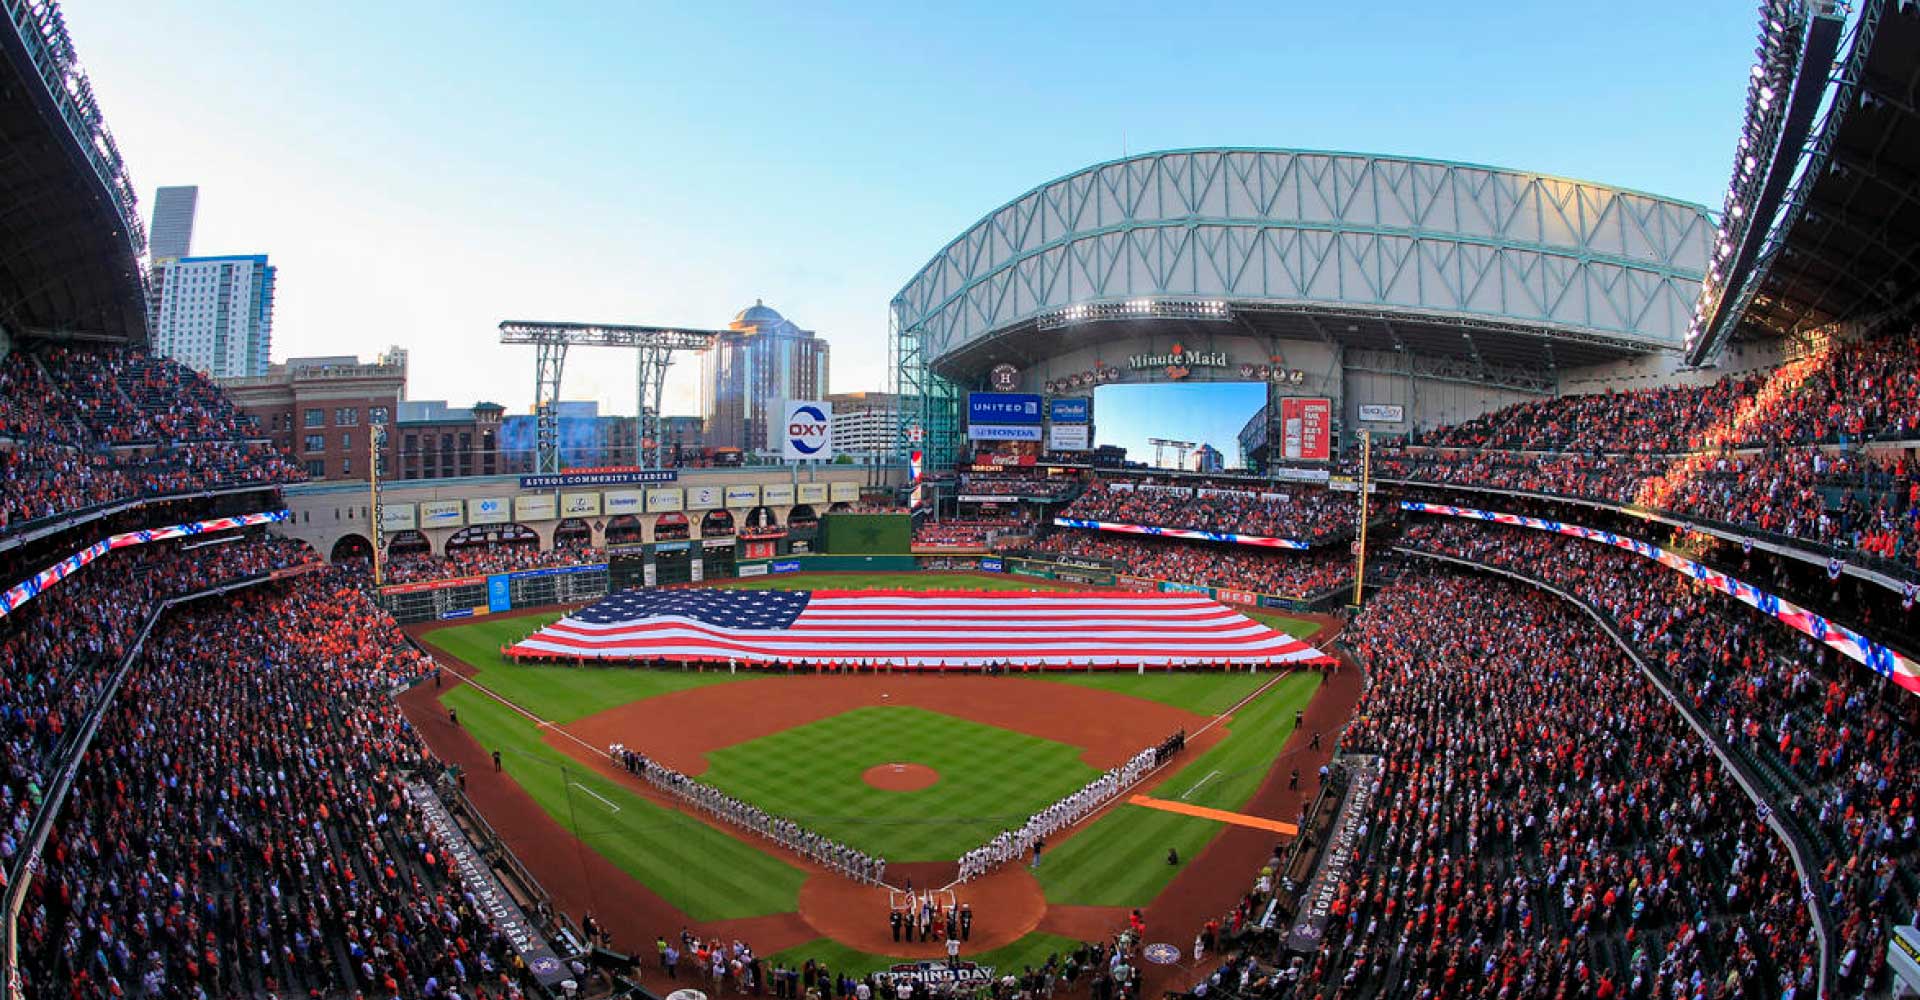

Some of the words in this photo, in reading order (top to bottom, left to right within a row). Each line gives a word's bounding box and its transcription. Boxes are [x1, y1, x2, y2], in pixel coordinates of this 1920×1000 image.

[1128, 353, 1183, 368] Minute
[1185, 350, 1226, 367] Maid
[974, 403, 1022, 412] UNITED
[789, 424, 827, 436] OXY
[988, 429, 1036, 437] HONDA
[526, 477, 564, 486] ASTROS
[567, 474, 628, 484] COMMUNITY
[632, 472, 673, 481] LEADERS
[1312, 884, 1335, 917] HOME
[958, 968, 994, 980] DAY
